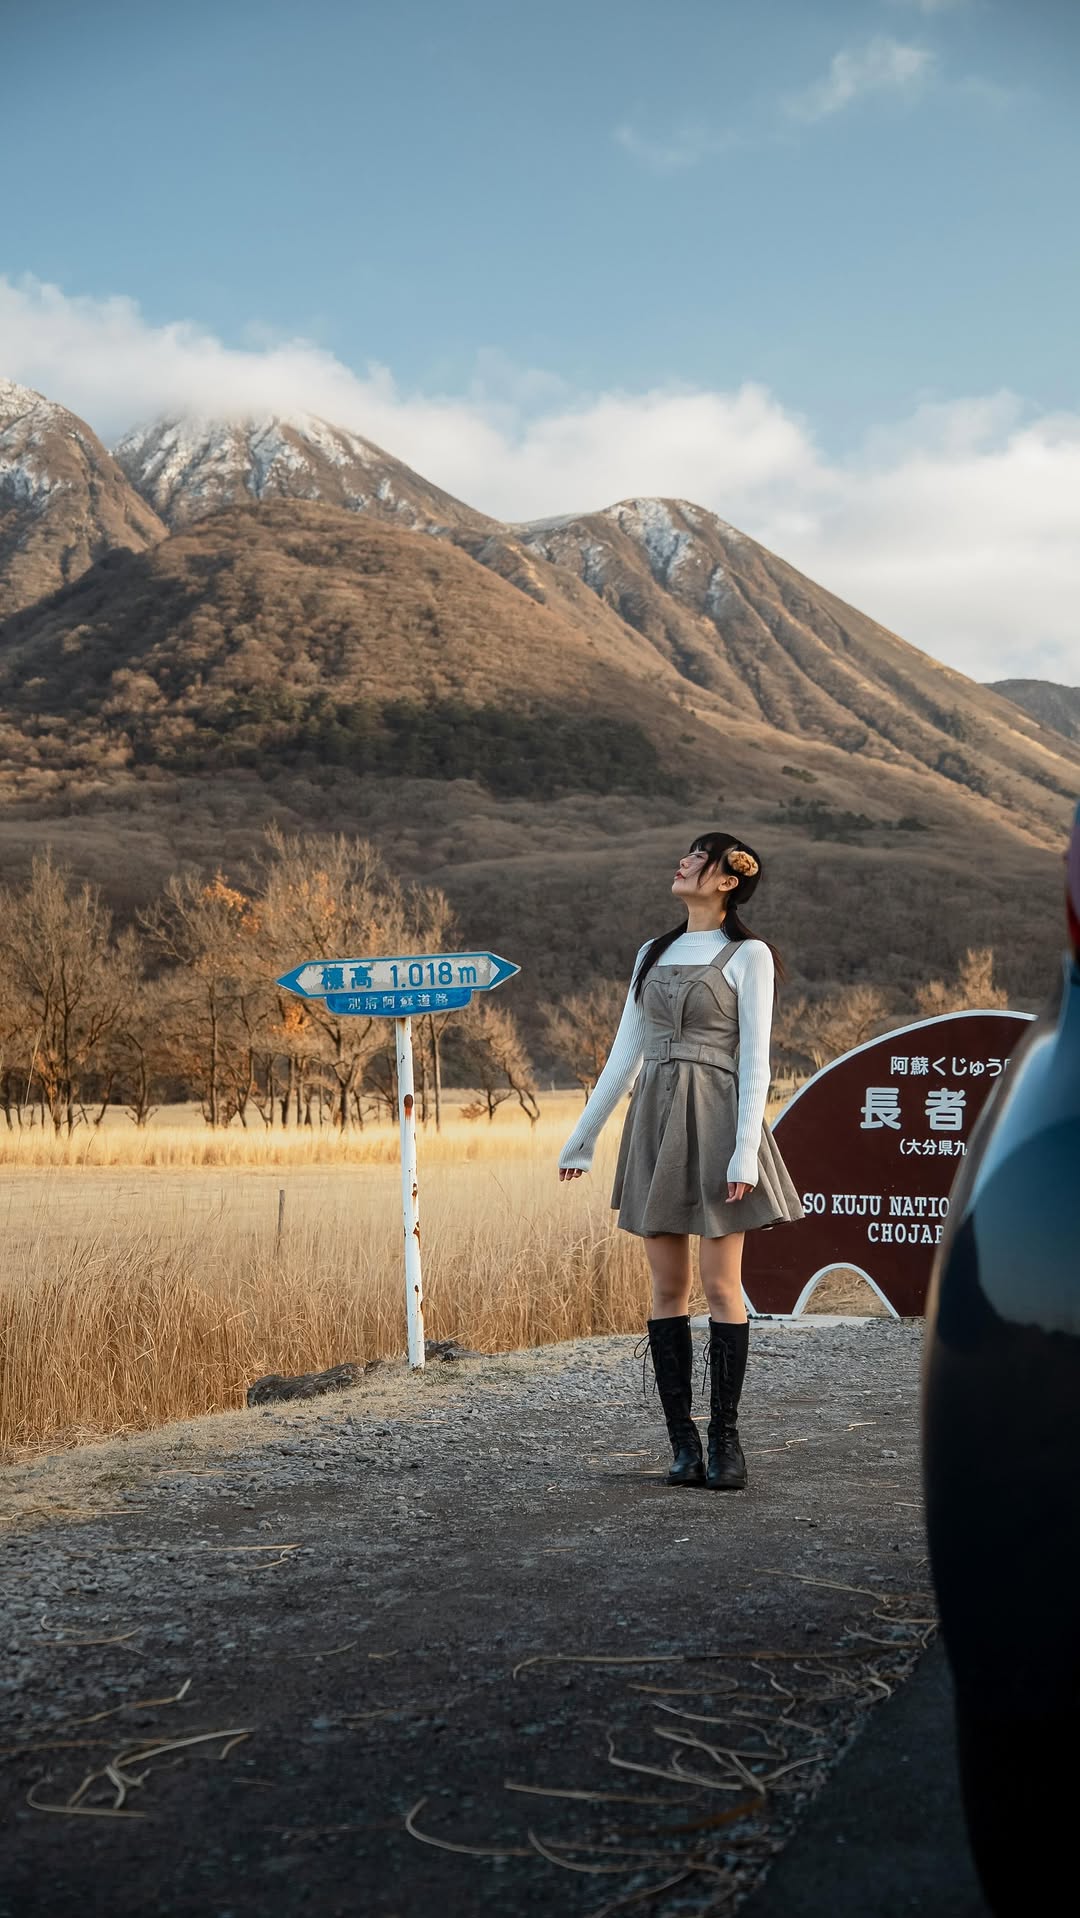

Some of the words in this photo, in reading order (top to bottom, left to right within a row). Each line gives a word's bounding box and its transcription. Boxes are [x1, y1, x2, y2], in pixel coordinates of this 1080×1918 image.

[320, 966, 372, 990] 標高
[890, 1056, 1012, 1077] 阿蘇くじゅう
[860, 1087, 967, 1131] 長者
[831, 1194, 882, 1216] KUJU
